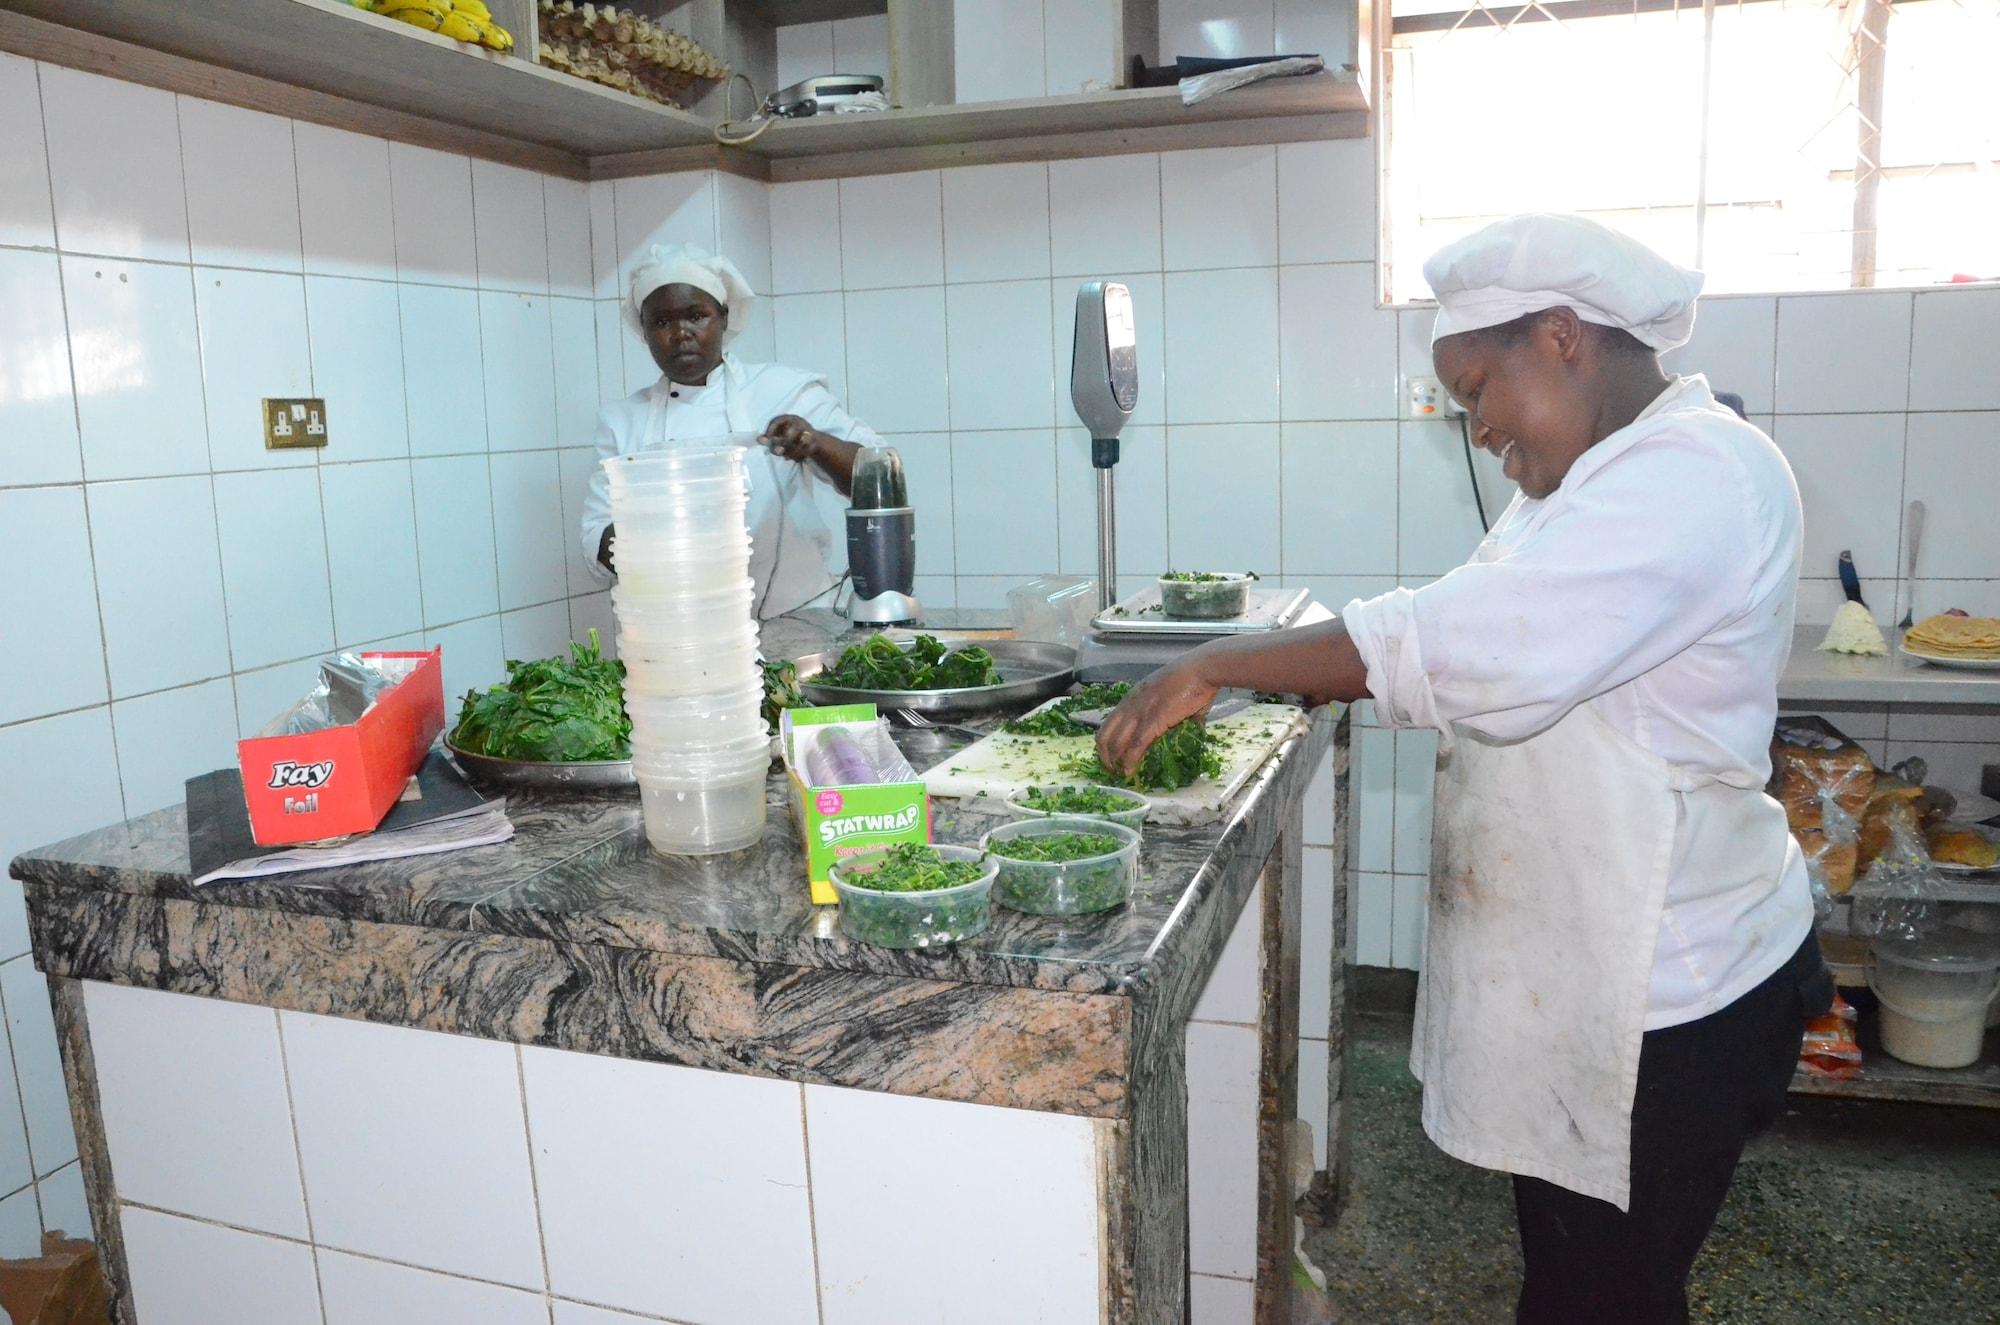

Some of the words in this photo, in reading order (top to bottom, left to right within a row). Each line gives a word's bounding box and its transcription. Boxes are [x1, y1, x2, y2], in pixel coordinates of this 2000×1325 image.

[268, 760, 333, 788] Fay
[284, 793, 318, 815] Foil
[819, 806, 918, 842] STATWRAP
